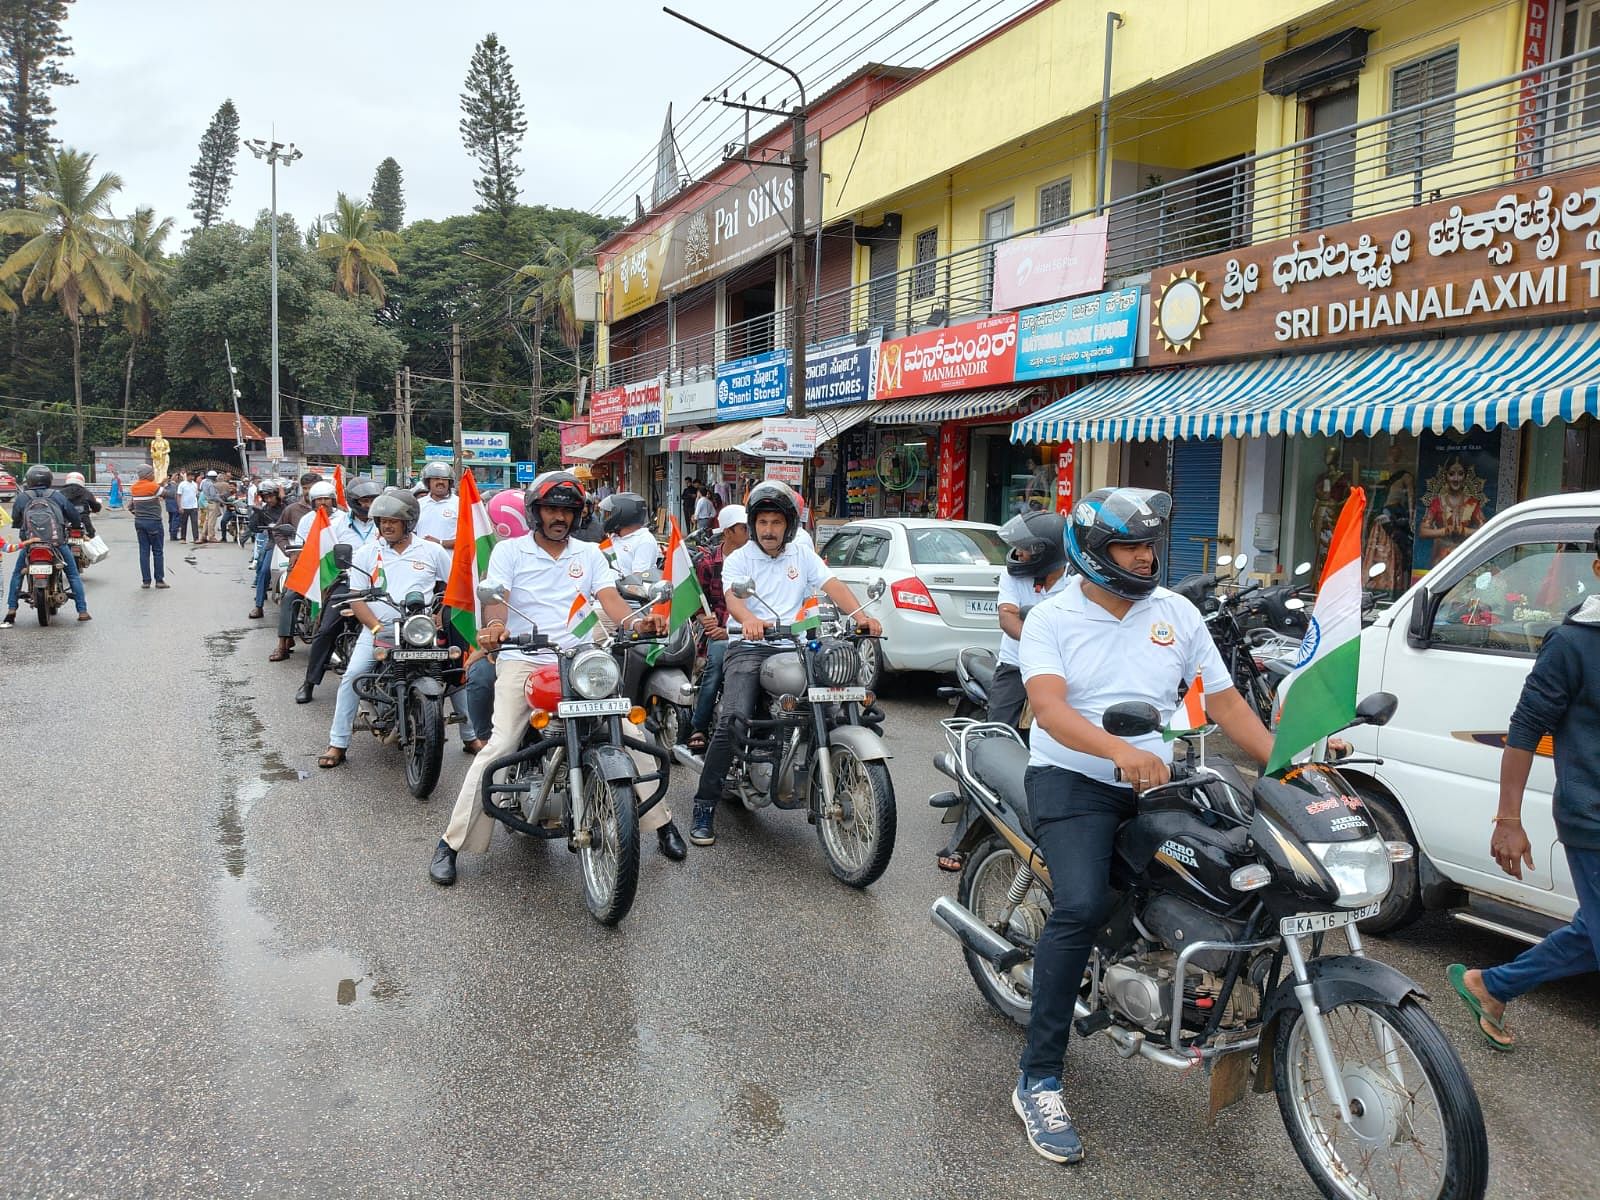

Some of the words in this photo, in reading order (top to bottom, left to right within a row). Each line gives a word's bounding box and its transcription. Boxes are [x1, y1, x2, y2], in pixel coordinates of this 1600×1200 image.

[714, 198, 739, 246] Pai
[747, 176, 794, 228] Silks
[1220, 258, 1259, 311] ಶ್ರೀ
[1274, 305, 1319, 342] SRI
[1328, 264, 1567, 334] DHANALAXMI
[922, 360, 988, 382] MANMANDIR
[728, 389, 752, 405] Shanti
[753, 387, 780, 401] Stores
[805, 384, 828, 401] HANTI
[829, 379, 861, 398] STORES
[971, 602, 981, 611] KA
[983, 602, 993, 611] 44
[1330, 815, 1362, 825] HERO
[1330, 820, 1369, 832] HONDA
[1158, 845, 1199, 868] HONDA
[1297, 918, 1313, 932] KA
[1322, 915, 1335, 928] 16
[1343, 912, 1349, 923] J
